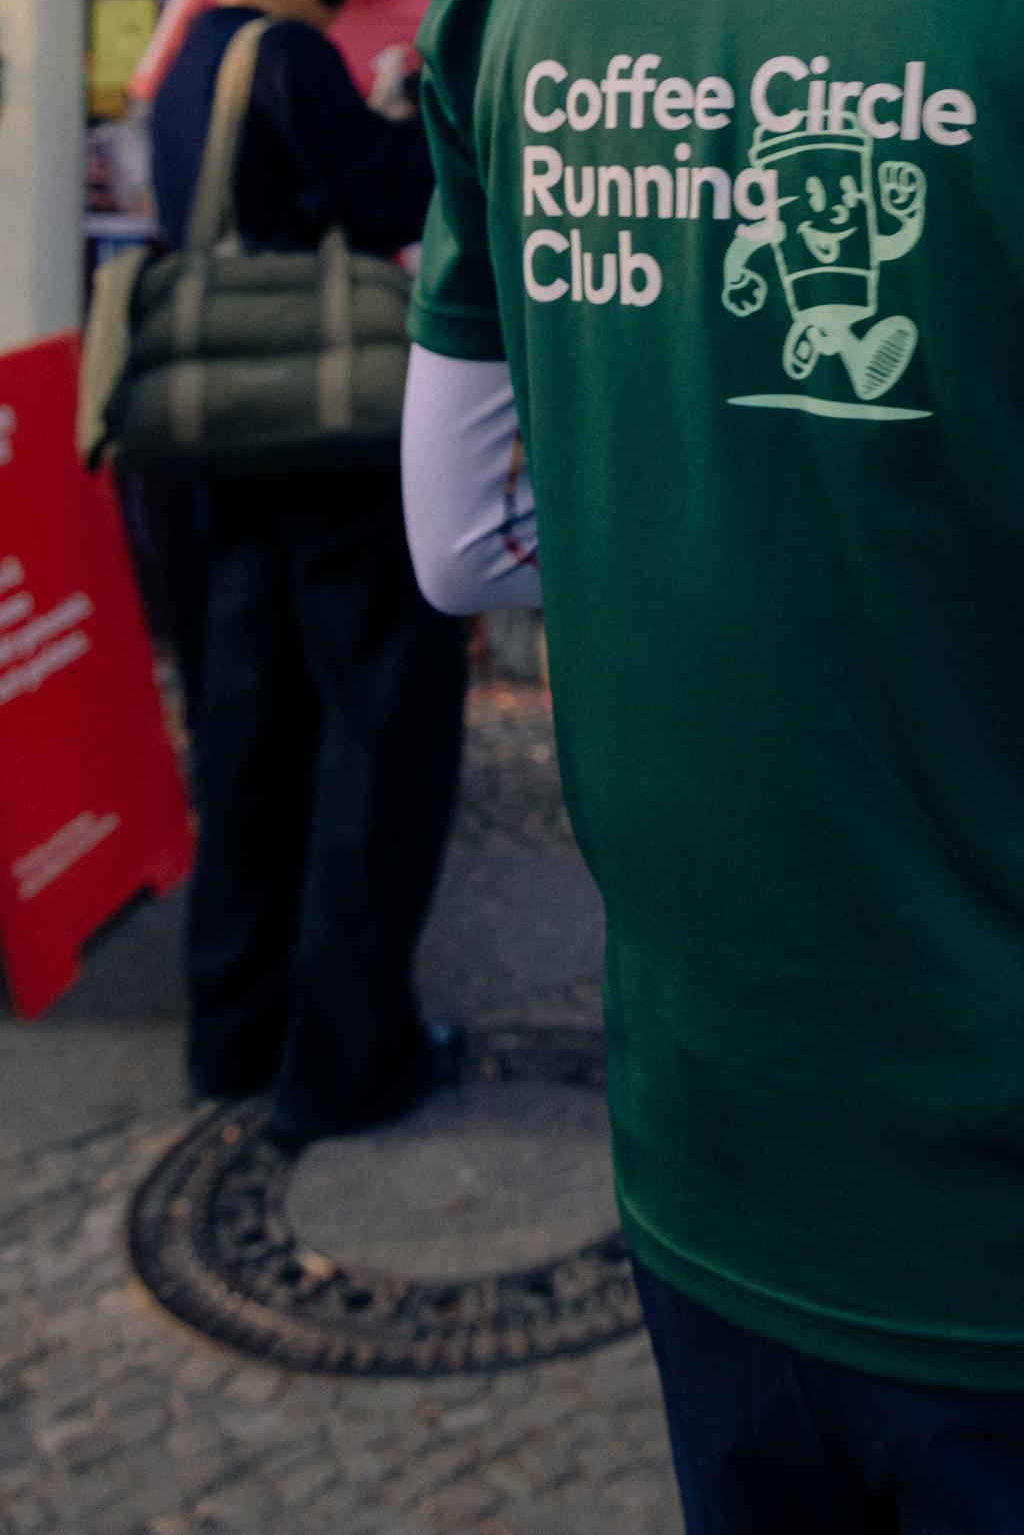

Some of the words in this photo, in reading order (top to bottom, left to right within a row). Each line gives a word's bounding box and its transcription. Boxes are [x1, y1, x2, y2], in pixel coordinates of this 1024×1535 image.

[523, 53, 736, 133] Coffee
[750, 55, 977, 146] Circle
[523, 142, 780, 241] Running
[523, 229, 662, 307] Club
